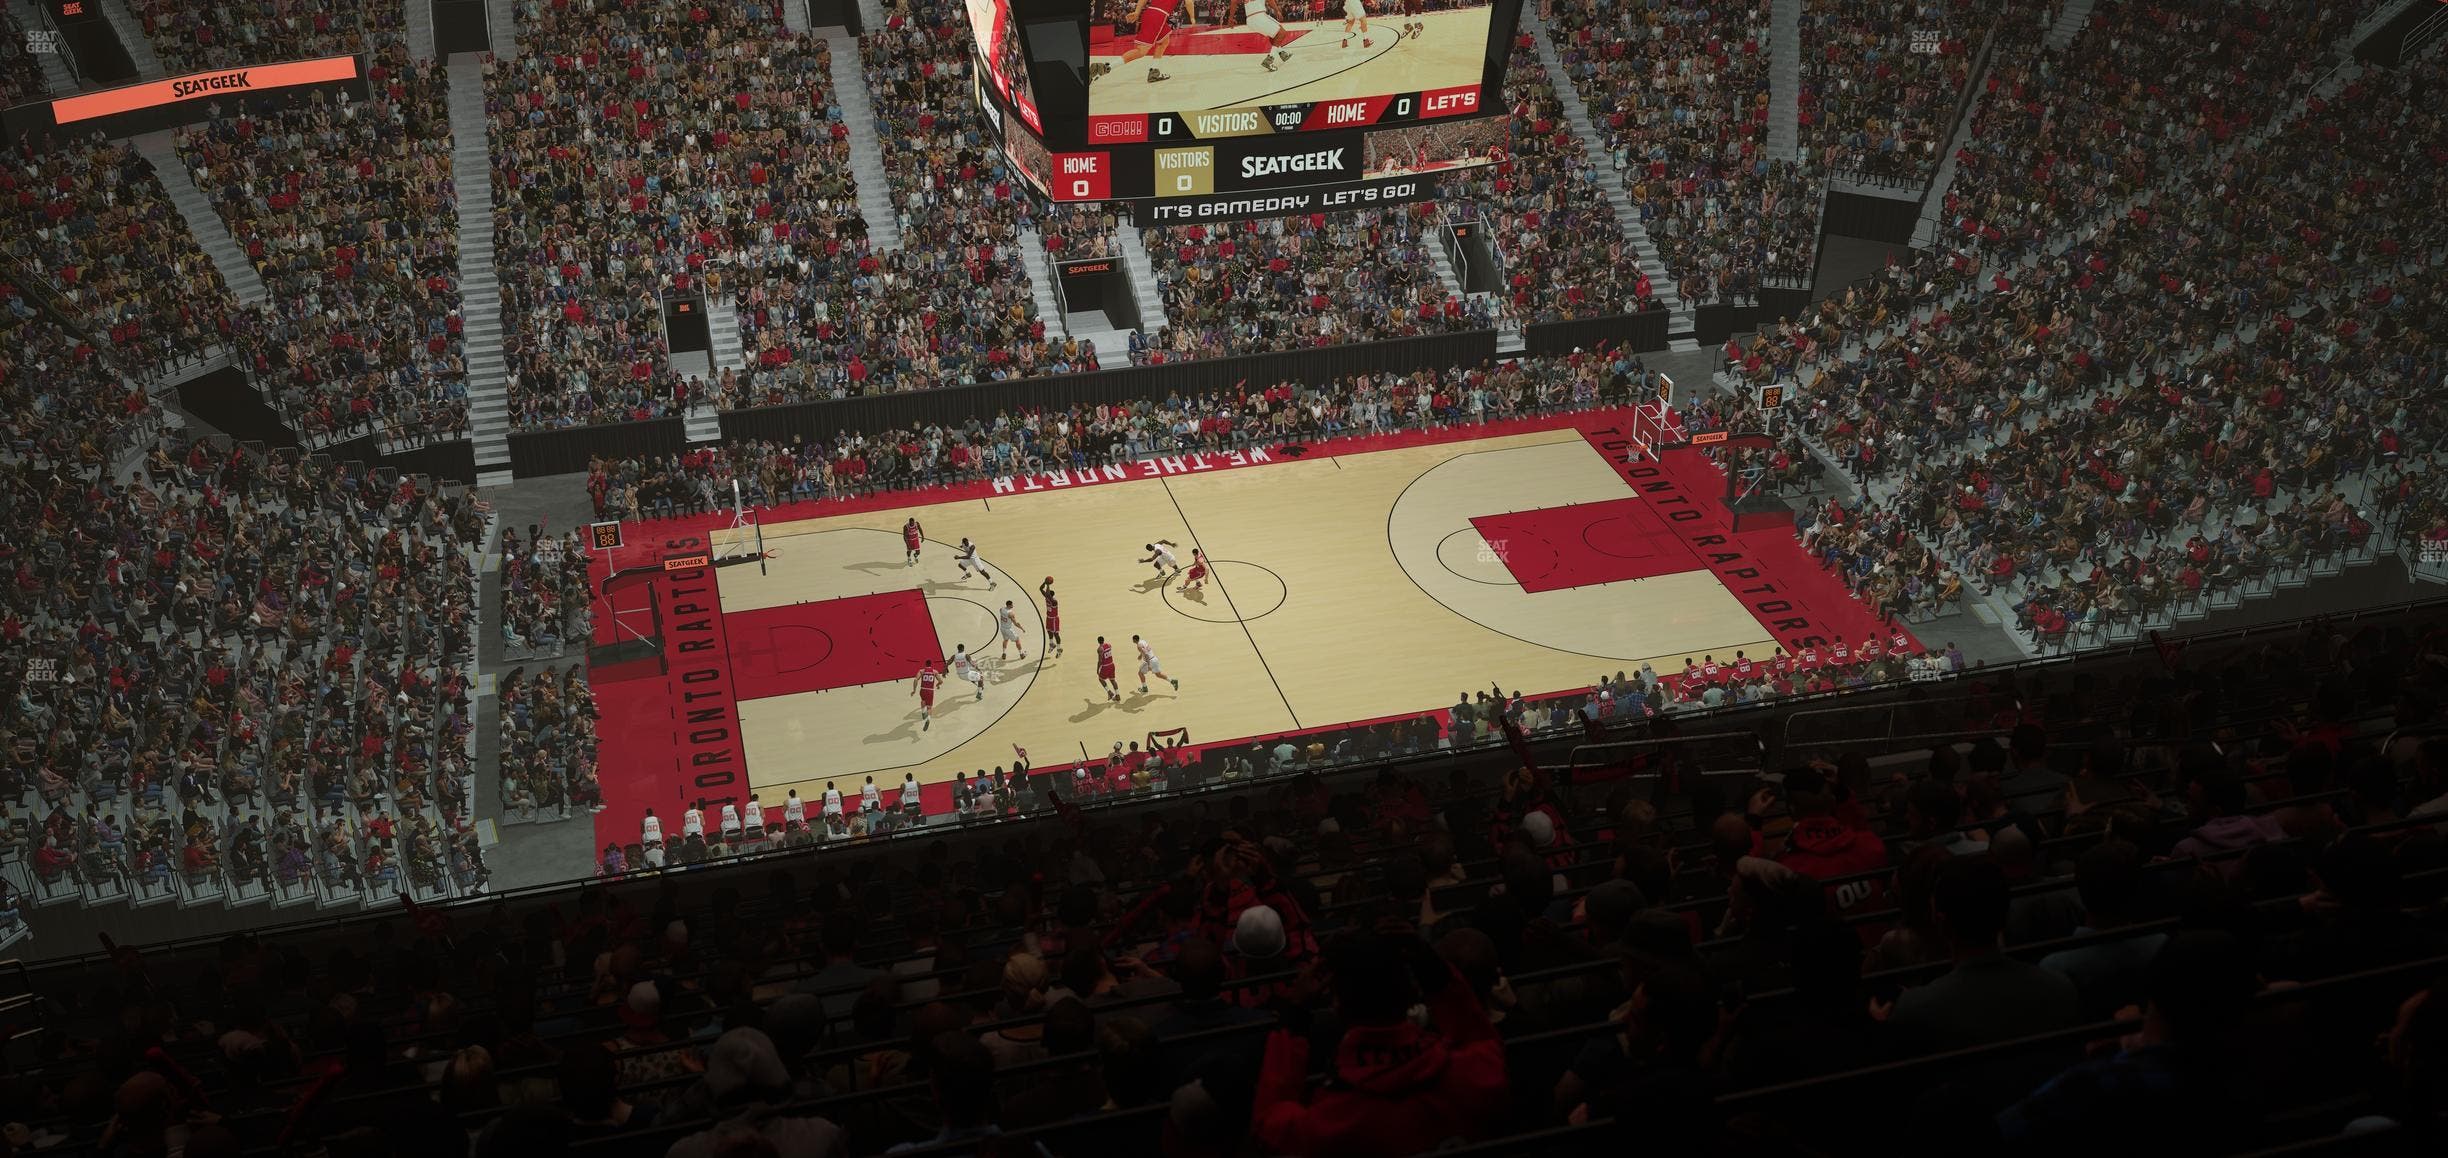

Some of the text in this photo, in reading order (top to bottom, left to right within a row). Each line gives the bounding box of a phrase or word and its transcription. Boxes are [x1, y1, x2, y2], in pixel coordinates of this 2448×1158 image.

[172, 72, 251, 97] SEATGEEK
[1327, 98, 1411, 124] HOME 0
[1427, 92, 1476, 111] LET'S
[1158, 112, 1258, 135] 0 VISITORS
[1275, 111, 1302, 126] 00:00
[1095, 121, 1143, 136] GO!!!
[1063, 157, 1097, 174] HOME
[1159, 151, 1210, 169] VISITORS
[1241, 147, 1344, 178] SEATGEEK
[1072, 180, 1089, 197] 0
[1176, 174, 1192, 191] 0
[1322, 183, 1416, 206] LET'S GO!
[1153, 195, 1310, 220] IT'S GAMEDAY
[1067, 263, 1110, 274] SEATGEEK
[1137, 453, 1213, 476] THE
[992, 463, 1127, 494] NORTH
[1692, 535, 1827, 649] RAPTORS
[666, 537, 738, 811] TORONTO RAPTOS
[1705, 666, 1718, 675] 00
[1739, 664, 1751, 673] 00
[922, 674, 934, 683] 00
